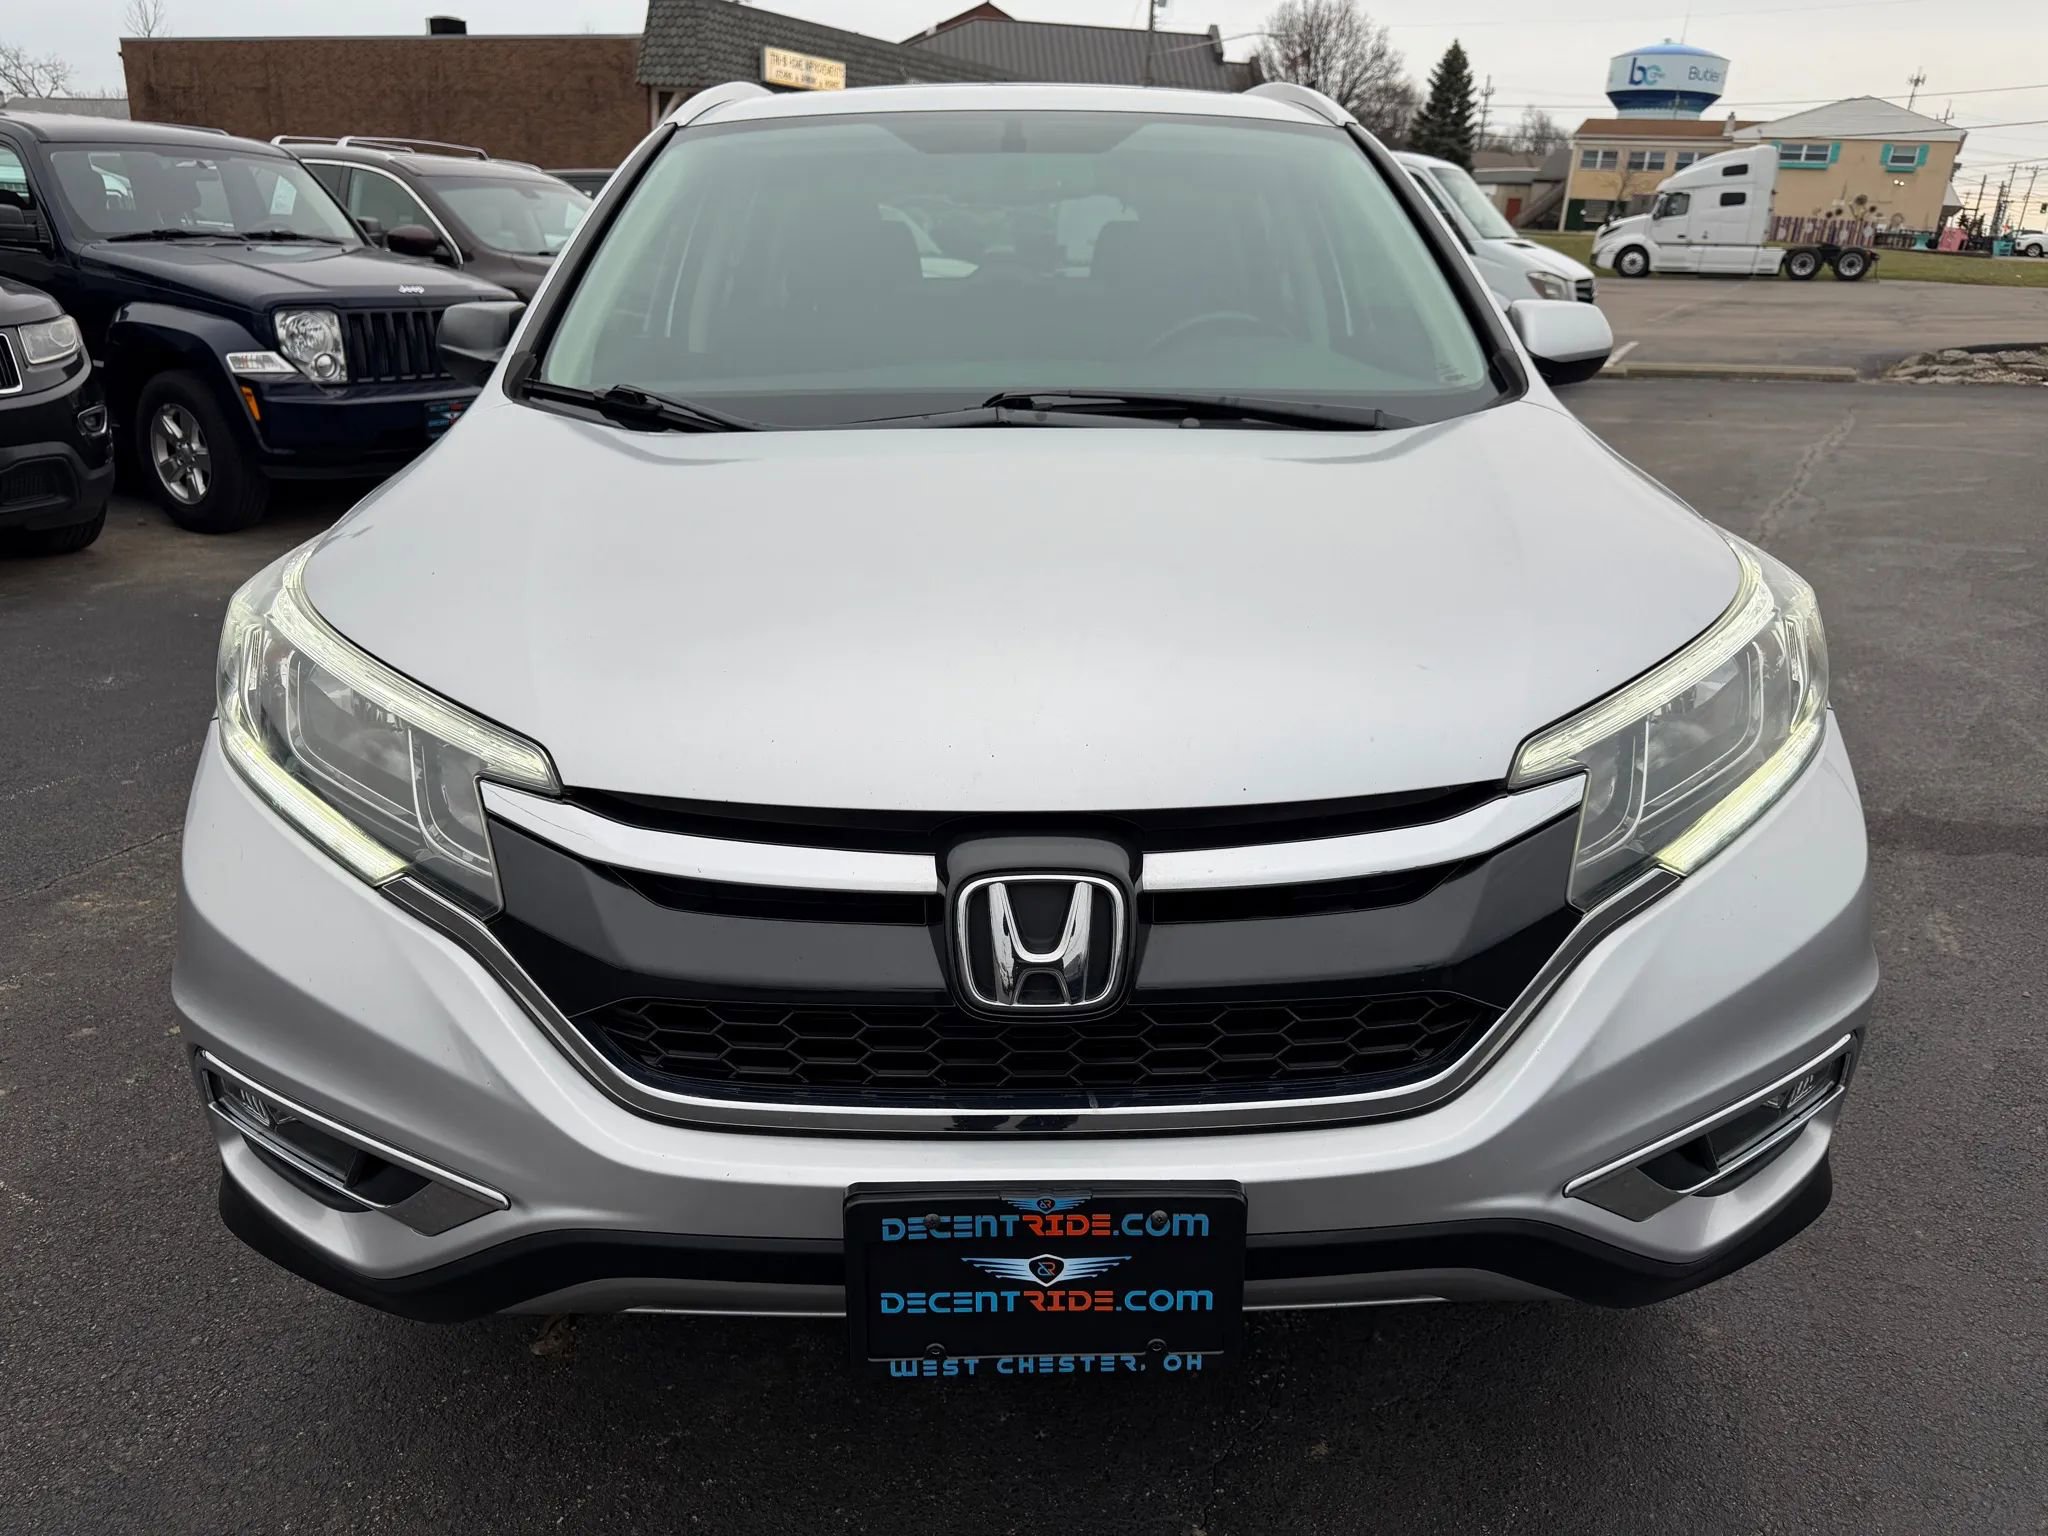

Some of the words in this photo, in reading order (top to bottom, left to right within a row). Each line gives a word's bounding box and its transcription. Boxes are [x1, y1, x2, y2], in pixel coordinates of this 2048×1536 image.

[889, 1357, 980, 1378] WEST
[996, 1354, 1146, 1375] CHESTER,
[1162, 1353, 1203, 1372] OH
